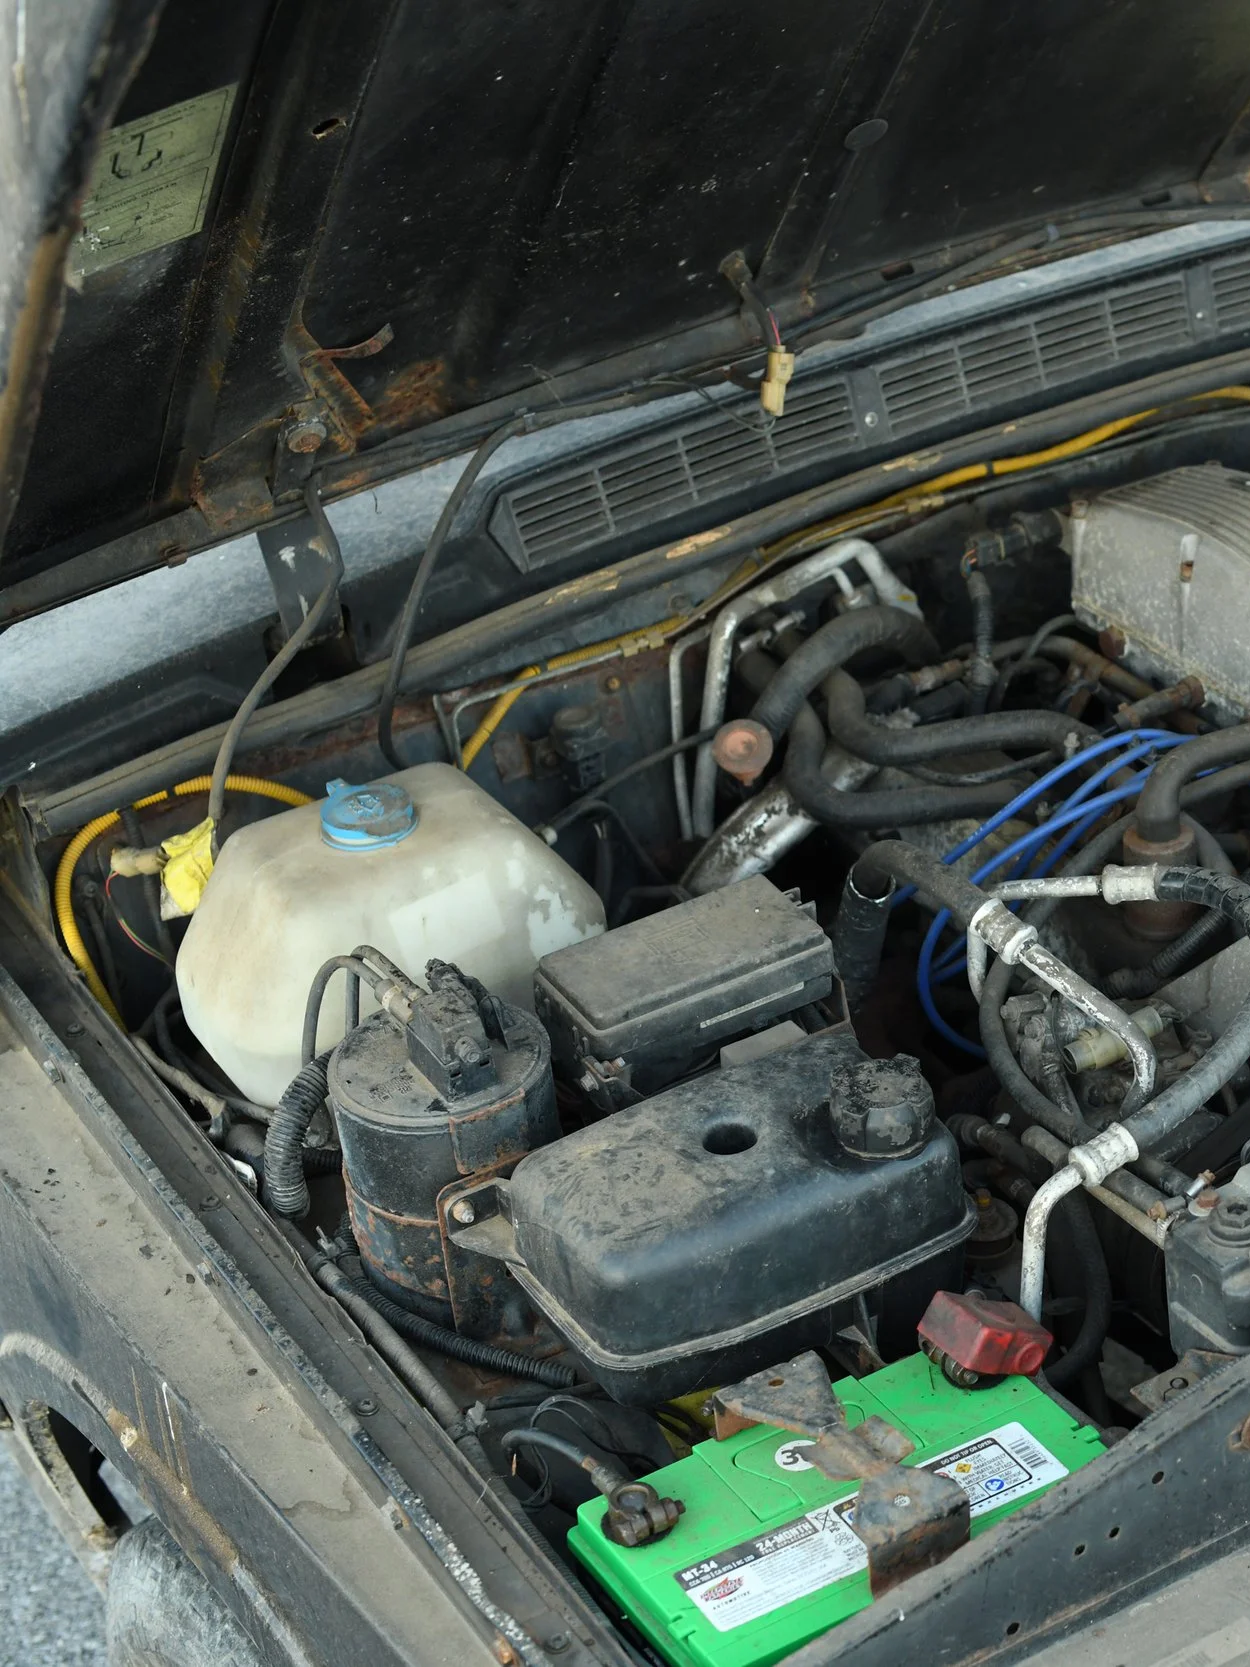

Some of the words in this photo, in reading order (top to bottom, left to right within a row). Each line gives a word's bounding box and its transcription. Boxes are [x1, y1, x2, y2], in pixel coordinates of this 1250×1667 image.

[755, 1521, 814, 1551] 24-MONTH
[681, 1560, 718, 1582] MT-34
[713, 1590, 750, 1610] AUTOMOTIVE
